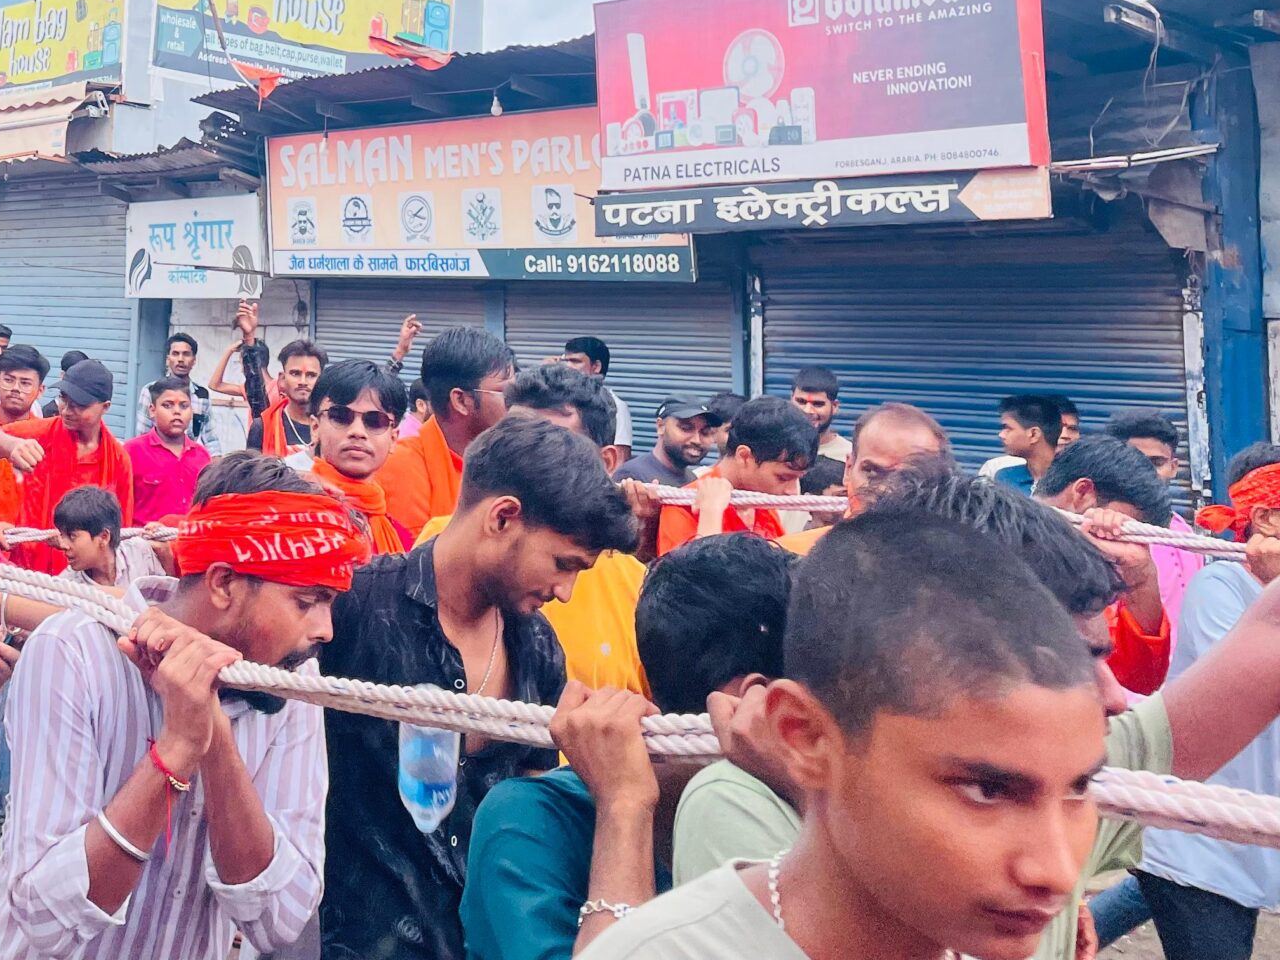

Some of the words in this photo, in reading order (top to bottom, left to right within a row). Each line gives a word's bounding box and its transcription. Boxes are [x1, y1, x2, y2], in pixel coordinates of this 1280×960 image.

[161, 12, 197, 30] wholesale
[825, 19, 872, 37] SWITCH
[877, 16, 894, 29] TO
[899, 11, 923, 26] THE
[927, 1, 993, 22] AMAZING
[240, 38, 249, 50] of
[9, 46, 51, 76] house
[853, 66, 894, 85] NEVER
[896, 62, 947, 80] ENDING
[887, 74, 972, 96] INNOVATION!
[279, 134, 414, 191] SALMAN
[424, 141, 504, 180] MEN'S
[623, 164, 671, 183] PATNA
[676, 157, 781, 180] ELECTRICALS
[601, 198, 703, 228] पटना
[148, 222, 177, 253] रूप
[289, 253, 305, 271] जैन
[353, 253, 365, 271] के
[524, 254, 562, 273] Call:
[566, 253, 681, 273] 9162118088
